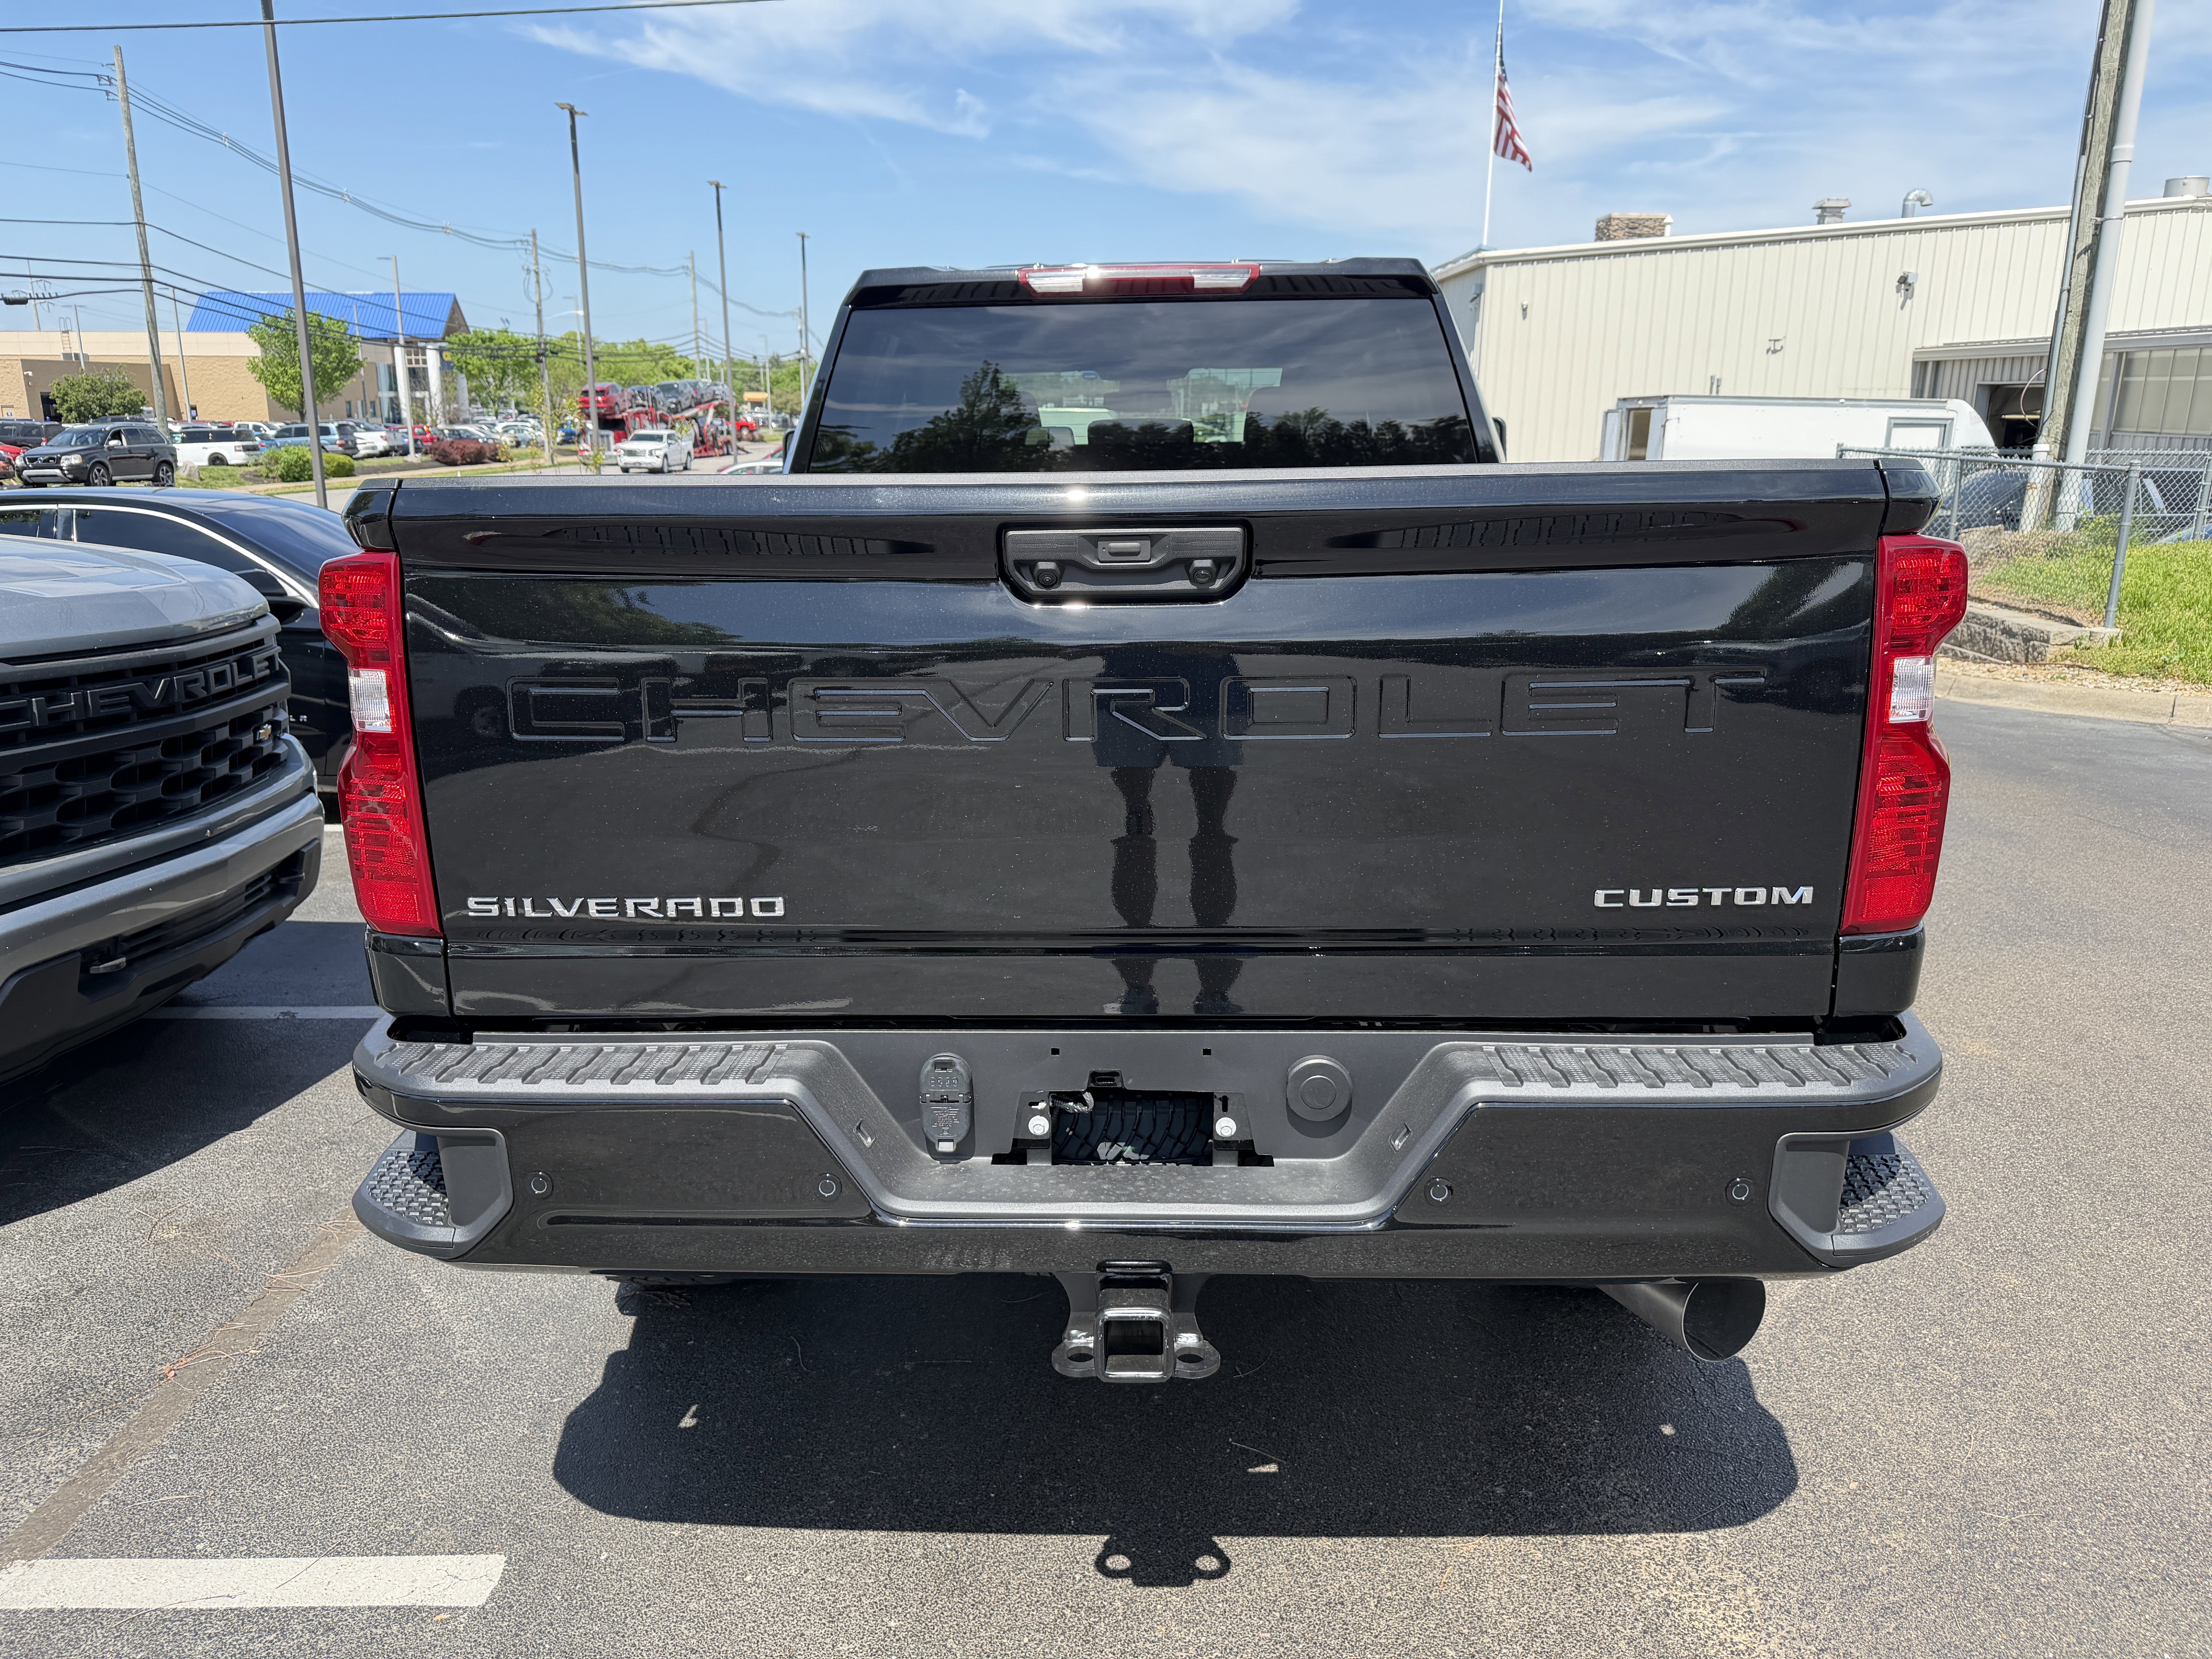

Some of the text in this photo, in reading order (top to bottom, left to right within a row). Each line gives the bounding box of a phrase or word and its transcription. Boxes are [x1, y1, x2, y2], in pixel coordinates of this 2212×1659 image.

[505, 664, 1768, 742] CHEVROLET
[466, 896, 786, 917] SILVERADO
[1594, 886, 1814, 908] CUSTOM
